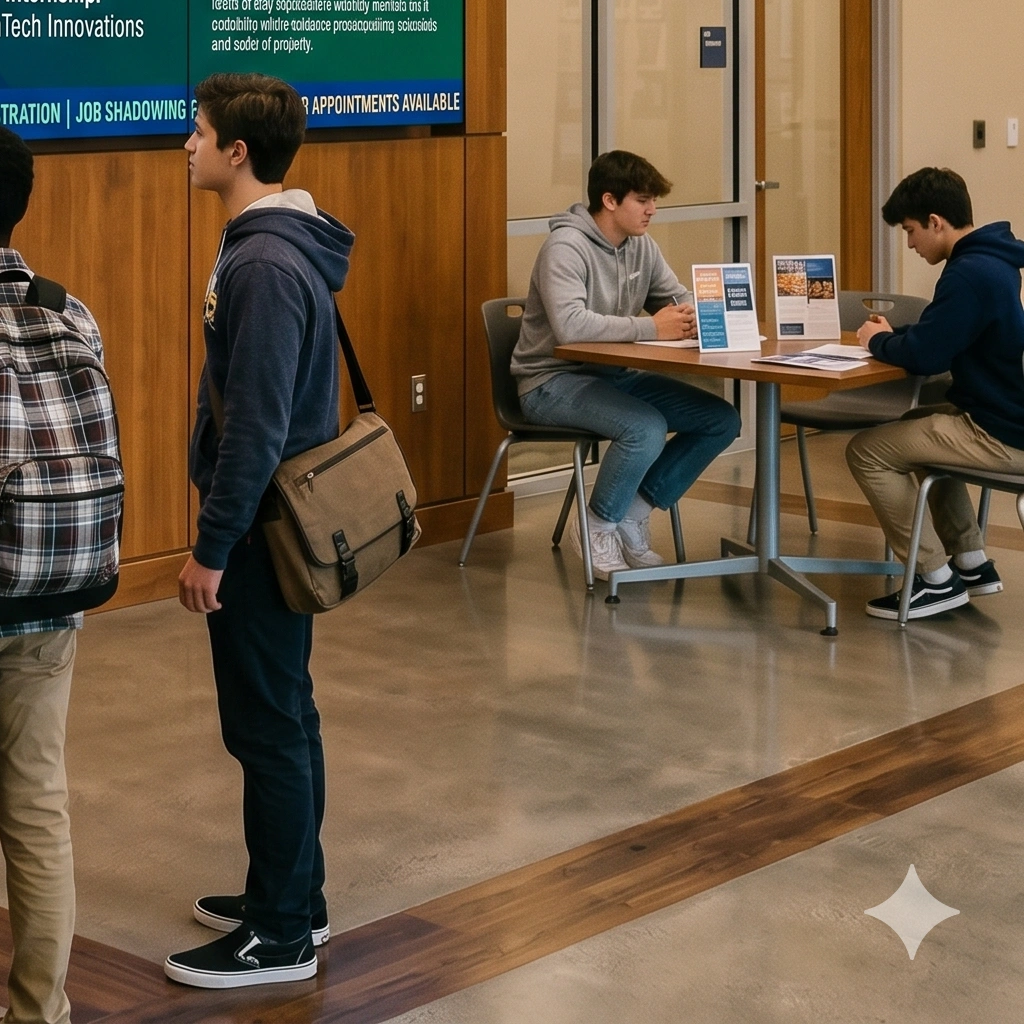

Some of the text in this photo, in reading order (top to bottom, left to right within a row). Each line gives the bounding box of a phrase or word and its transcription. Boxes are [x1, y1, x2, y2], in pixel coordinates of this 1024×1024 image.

[47, 14, 144, 39] Innovations
[211, 36, 231, 51] and
[261, 36, 272, 51] of
[75, 101, 102, 123] JOB
[105, 98, 186, 122] SHADOWING
[312, 94, 399, 115] APPOINTMENTS
[402, 92, 460, 112] AVAILABLE
